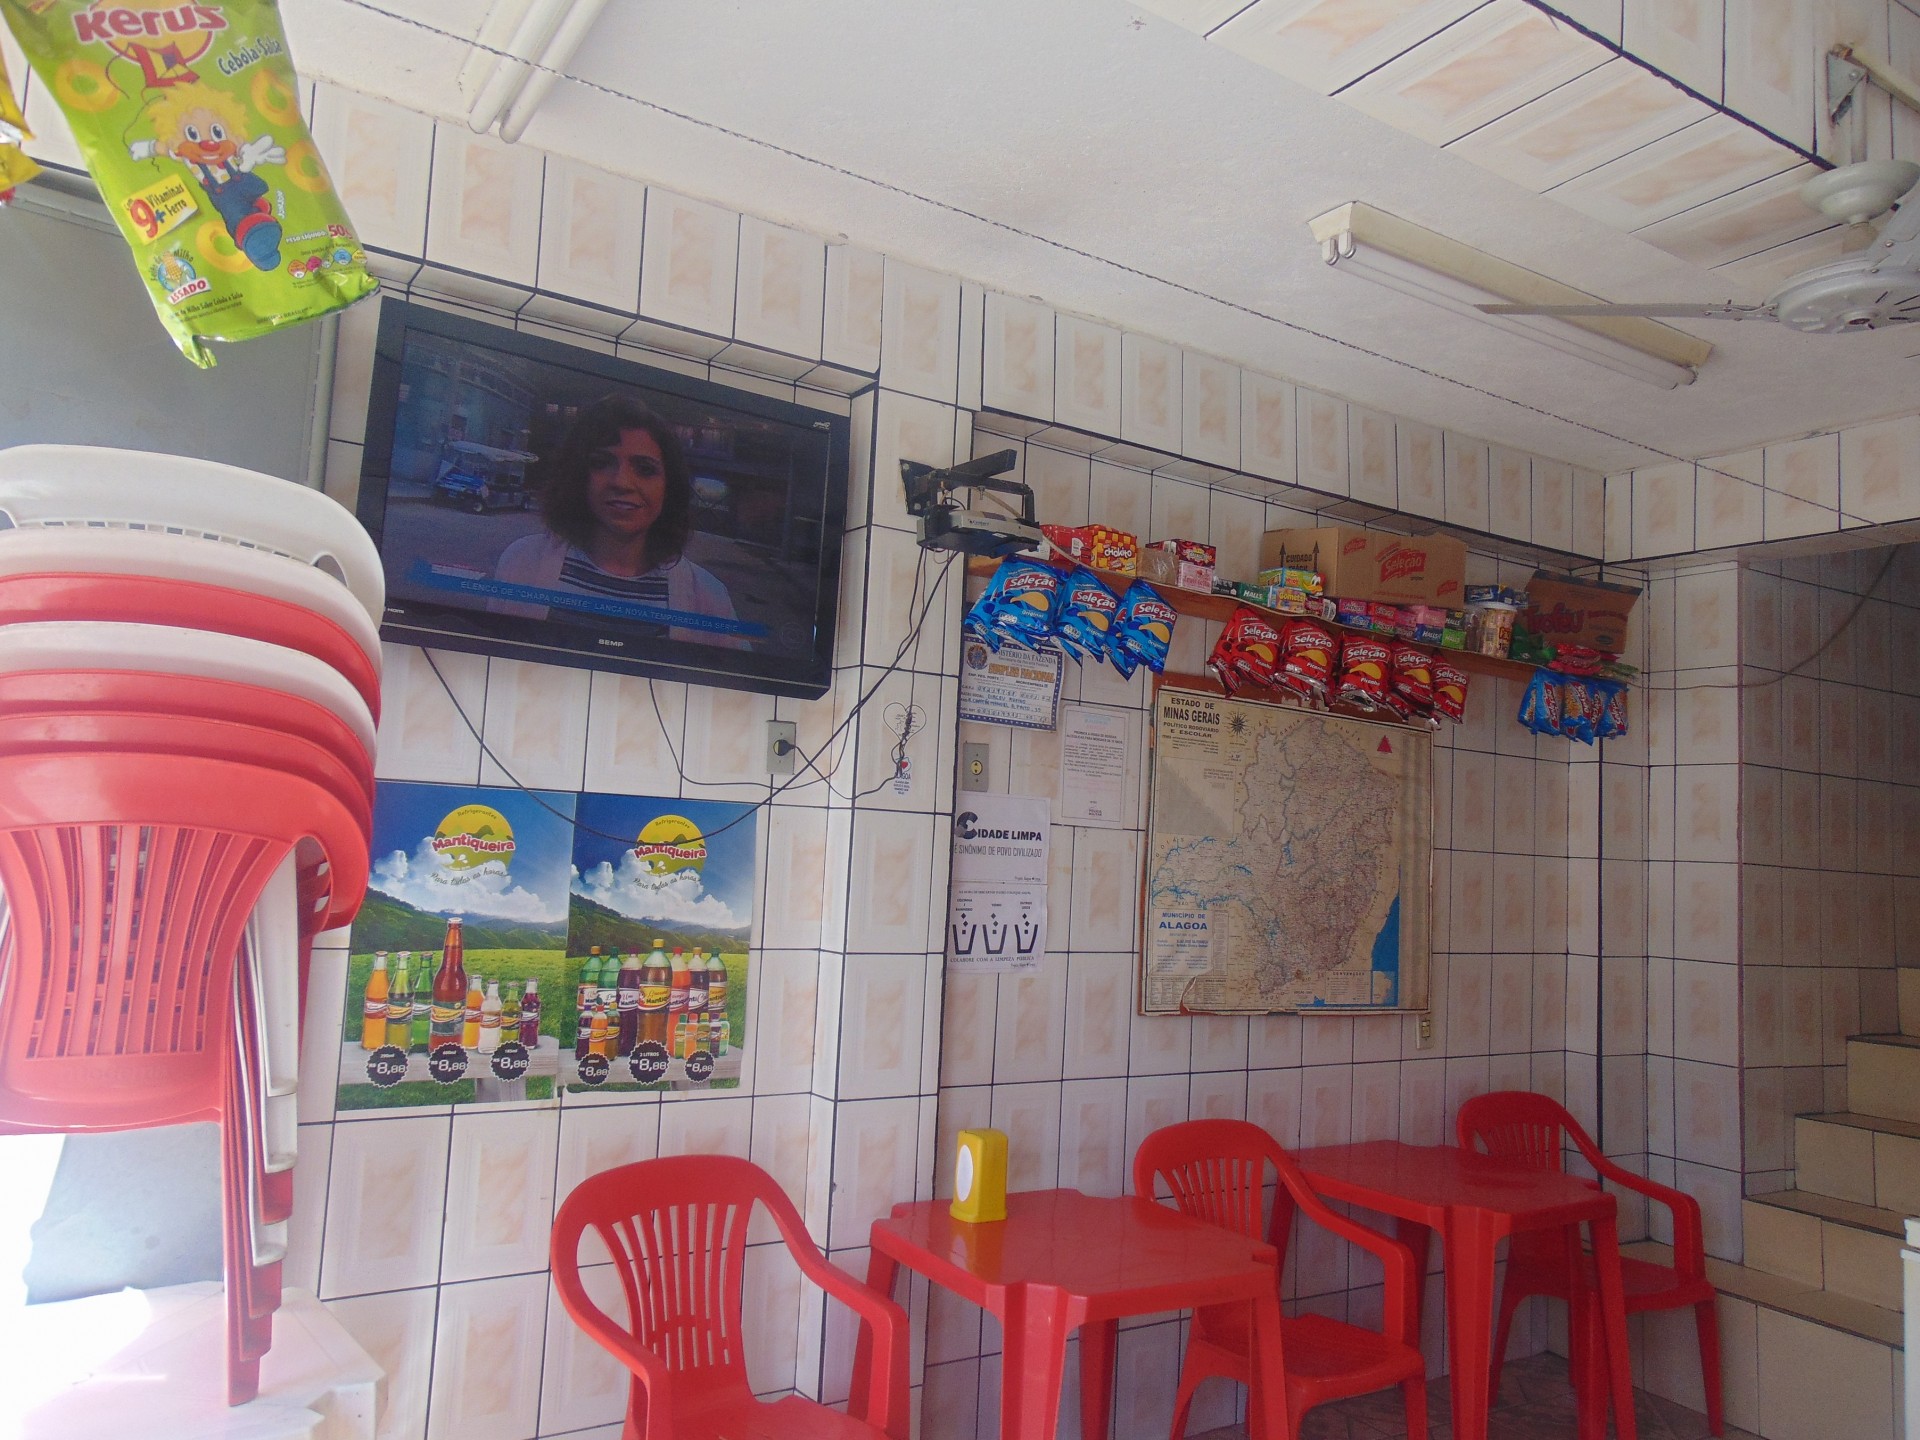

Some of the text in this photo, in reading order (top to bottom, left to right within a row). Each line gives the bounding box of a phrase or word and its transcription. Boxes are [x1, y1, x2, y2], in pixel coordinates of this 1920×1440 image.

[217, 46, 260, 75] Cebola
[145, 184, 185, 208] Vitaminas
[164, 198, 188, 217] Ferro
[130, 199, 158, 238] 9
[170, 280, 206, 303] ASSADO
[1009, 576, 1055, 588] Seleção
[1077, 592, 1116, 609] Seleção
[1243, 590, 1263, 600] HALLS
[461, 581, 498, 594] ELENCO
[501, 588, 513, 596] DE
[625, 606, 648, 618] NOVA
[651, 611, 701, 626] TEMPORADA
[1138, 603, 1176, 620] Seleção
[1244, 625, 1278, 640] Seleção
[1294, 635, 1332, 648] Seleção
[1347, 648, 1386, 659] Seleção
[1398, 654, 1432, 664] Seleção
[1436, 669, 1467, 685] Seleção
[1171, 697, 1215, 710] ESTADO DE
[1163, 706, 1220, 725] MINAS GERAIS
[1179, 730, 1212, 738] ESCOLAR
[954, 811, 1042, 841] CIDADE LIMPA
[431, 833, 516, 853] Mantiqueira
[634, 844, 706, 859] Mantiqueira
[958, 844, 987, 856] SINÔNIMO
[988, 848, 996, 856] DE
[996, 847, 1012, 857] POVO
[1012, 848, 1043, 858] CIVILIZADO
[1162, 911, 1195, 919] MUNICÍPIO
[1158, 921, 1208, 930] ALAGOA
